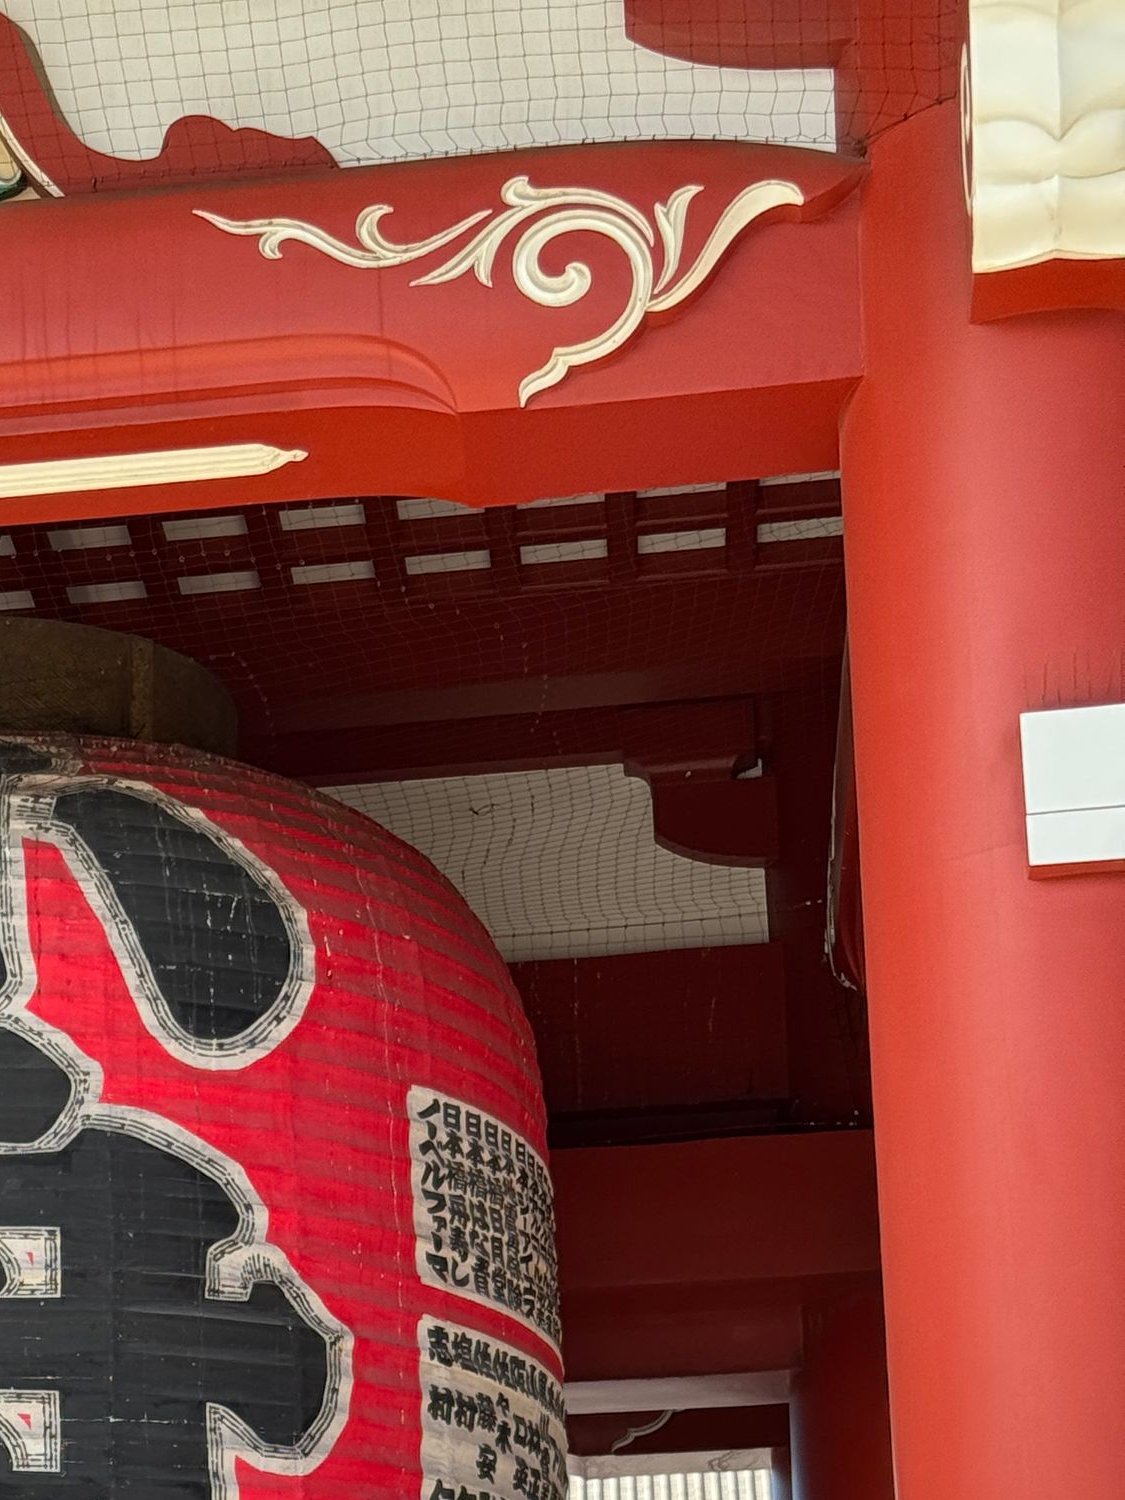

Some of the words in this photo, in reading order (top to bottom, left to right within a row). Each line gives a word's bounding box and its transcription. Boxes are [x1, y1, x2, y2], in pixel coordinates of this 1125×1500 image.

[418, 1098, 448, 1282] ノーベルファーマ
